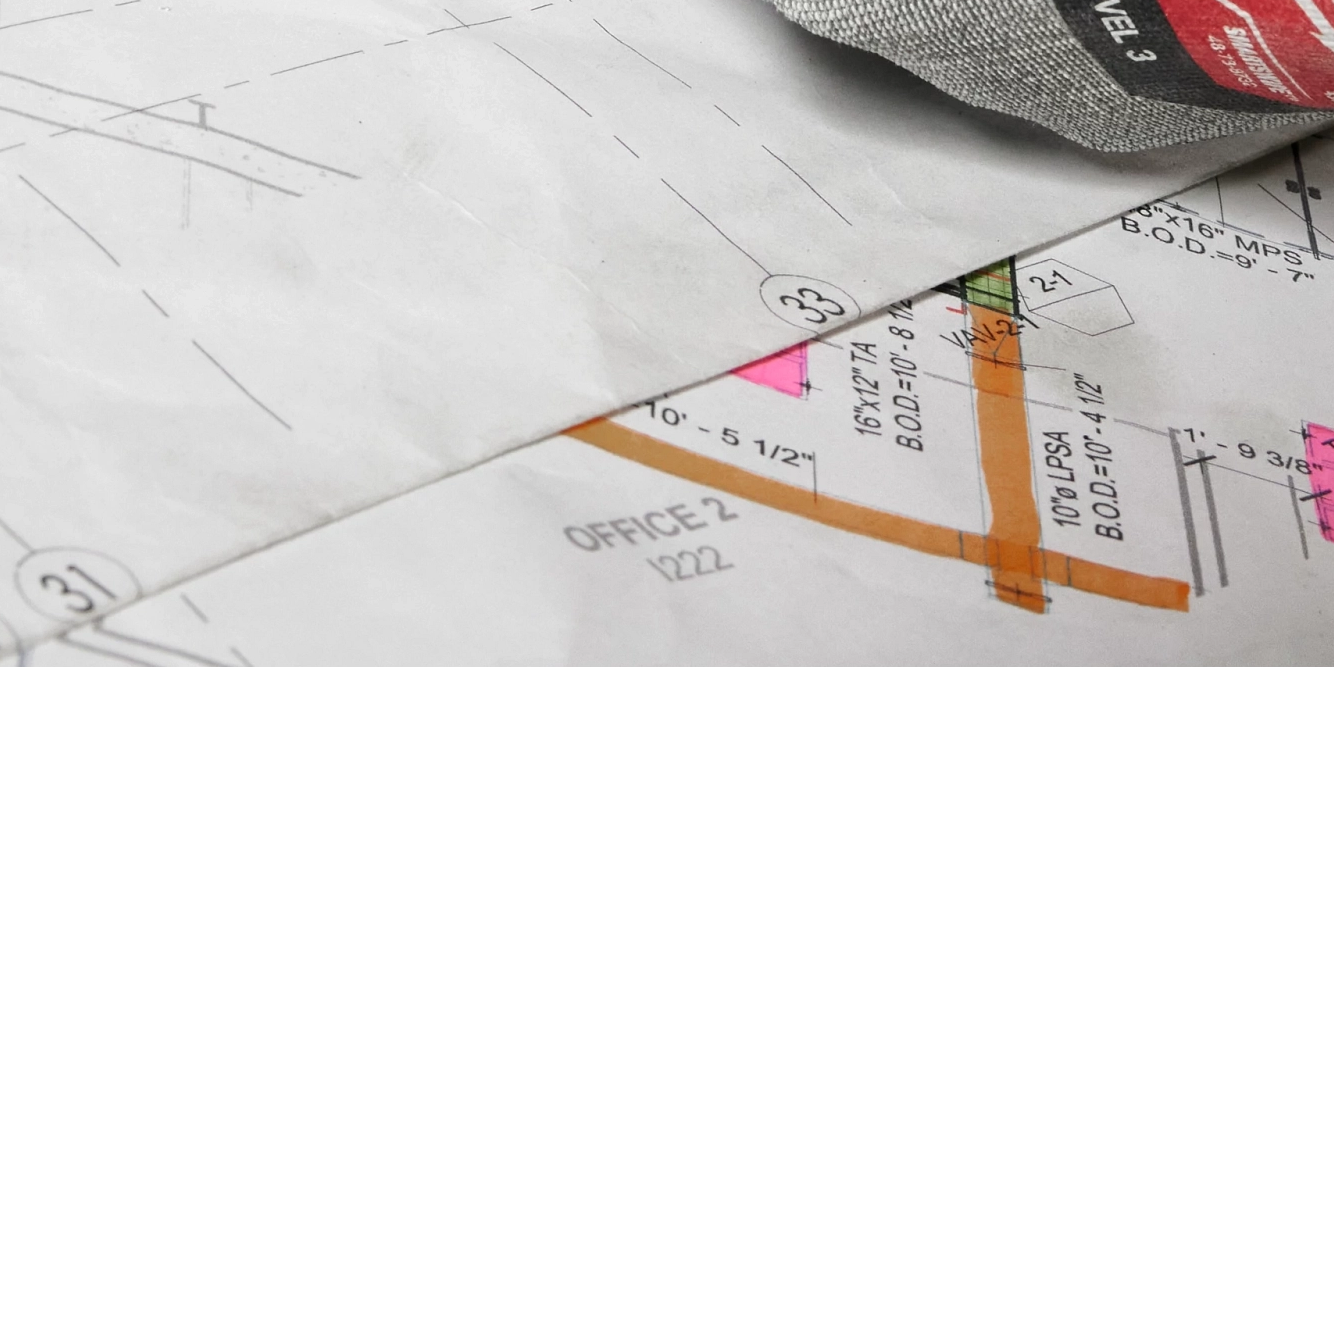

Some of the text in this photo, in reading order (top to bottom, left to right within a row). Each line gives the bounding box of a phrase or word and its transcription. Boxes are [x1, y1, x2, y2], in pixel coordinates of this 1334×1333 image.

[1126, 49, 1157, 61] 3
[1234, 235, 1304, 266] MPS
[1029, 270, 1074, 293] 2-1
[779, 287, 845, 324] 33
[889, 325, 915, 341] 8
[850, 341, 882, 436] 16"x12" TA
[1080, 410, 1107, 425] 4
[721, 428, 739, 446] 5
[1043, 431, 1075, 482] LPSA
[1237, 443, 1257, 459] 9
[563, 496, 740, 552] OFFICE 2
[40, 564, 117, 615] 31
